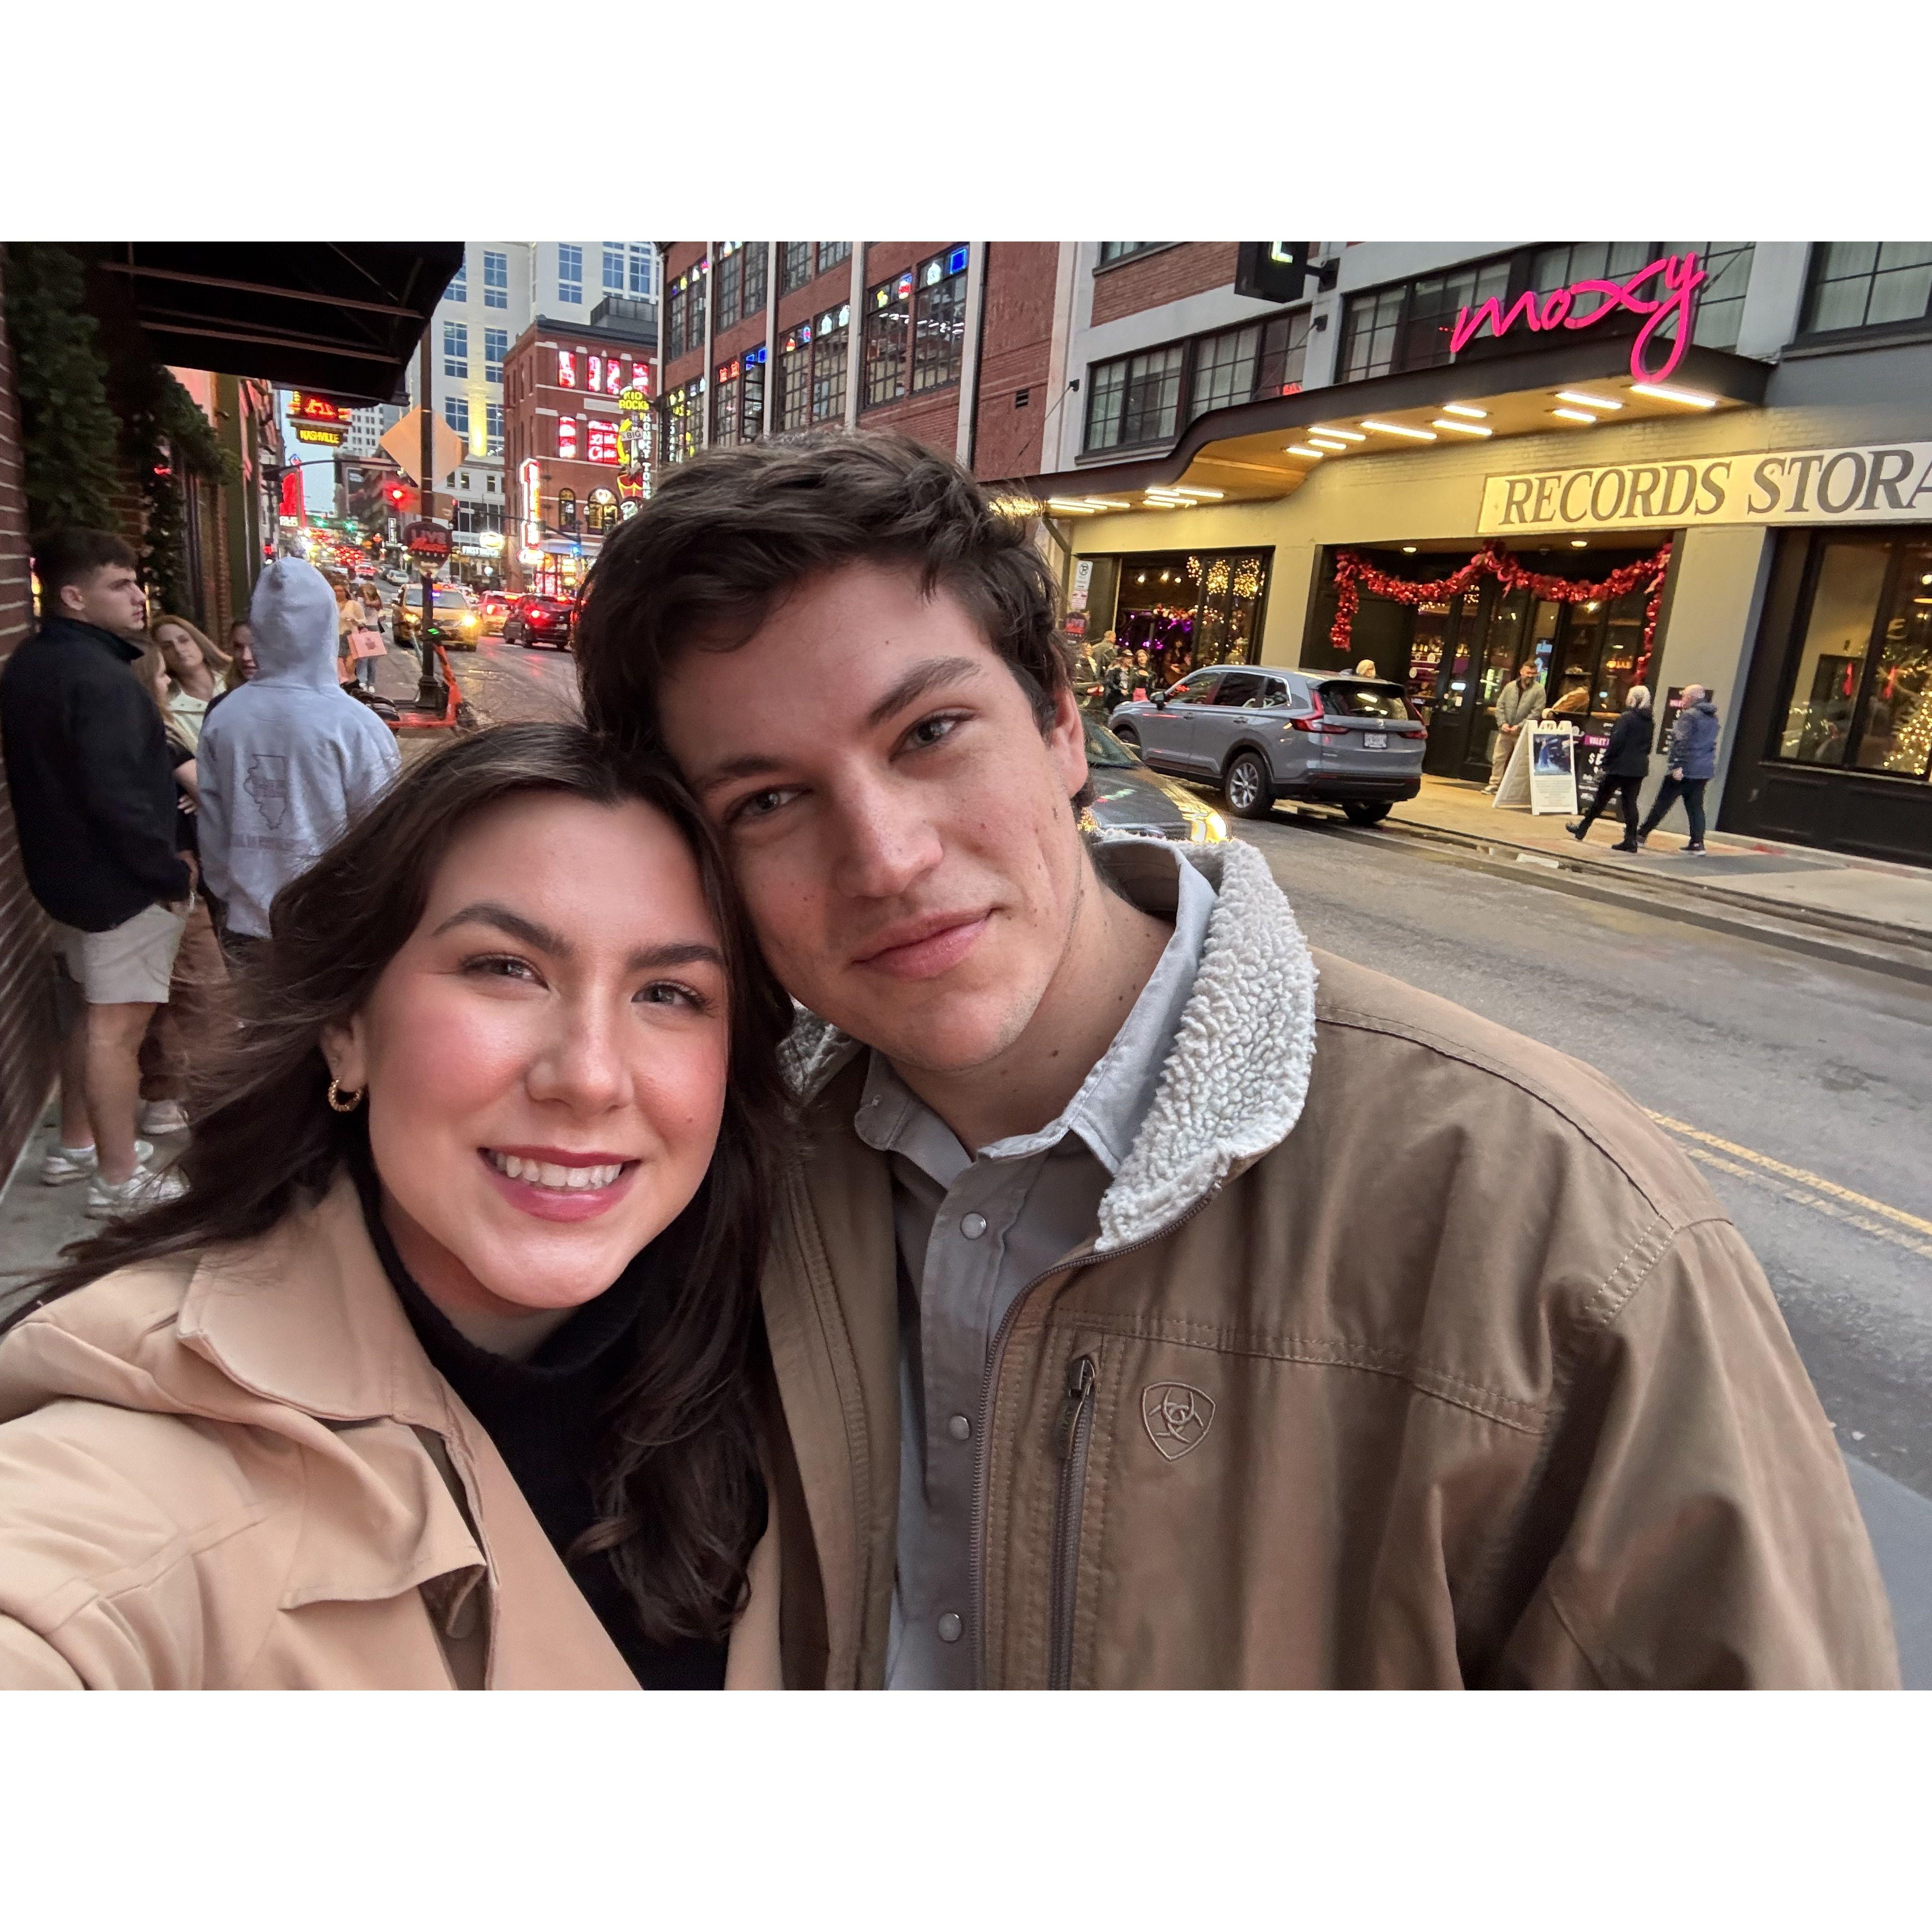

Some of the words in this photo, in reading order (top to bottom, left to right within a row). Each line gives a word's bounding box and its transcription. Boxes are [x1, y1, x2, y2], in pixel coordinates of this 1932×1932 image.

[623, 391, 643, 400] KID
[300, 430, 339, 444] NASHVILLE
[1498, 461, 1732, 525] RECORDS
